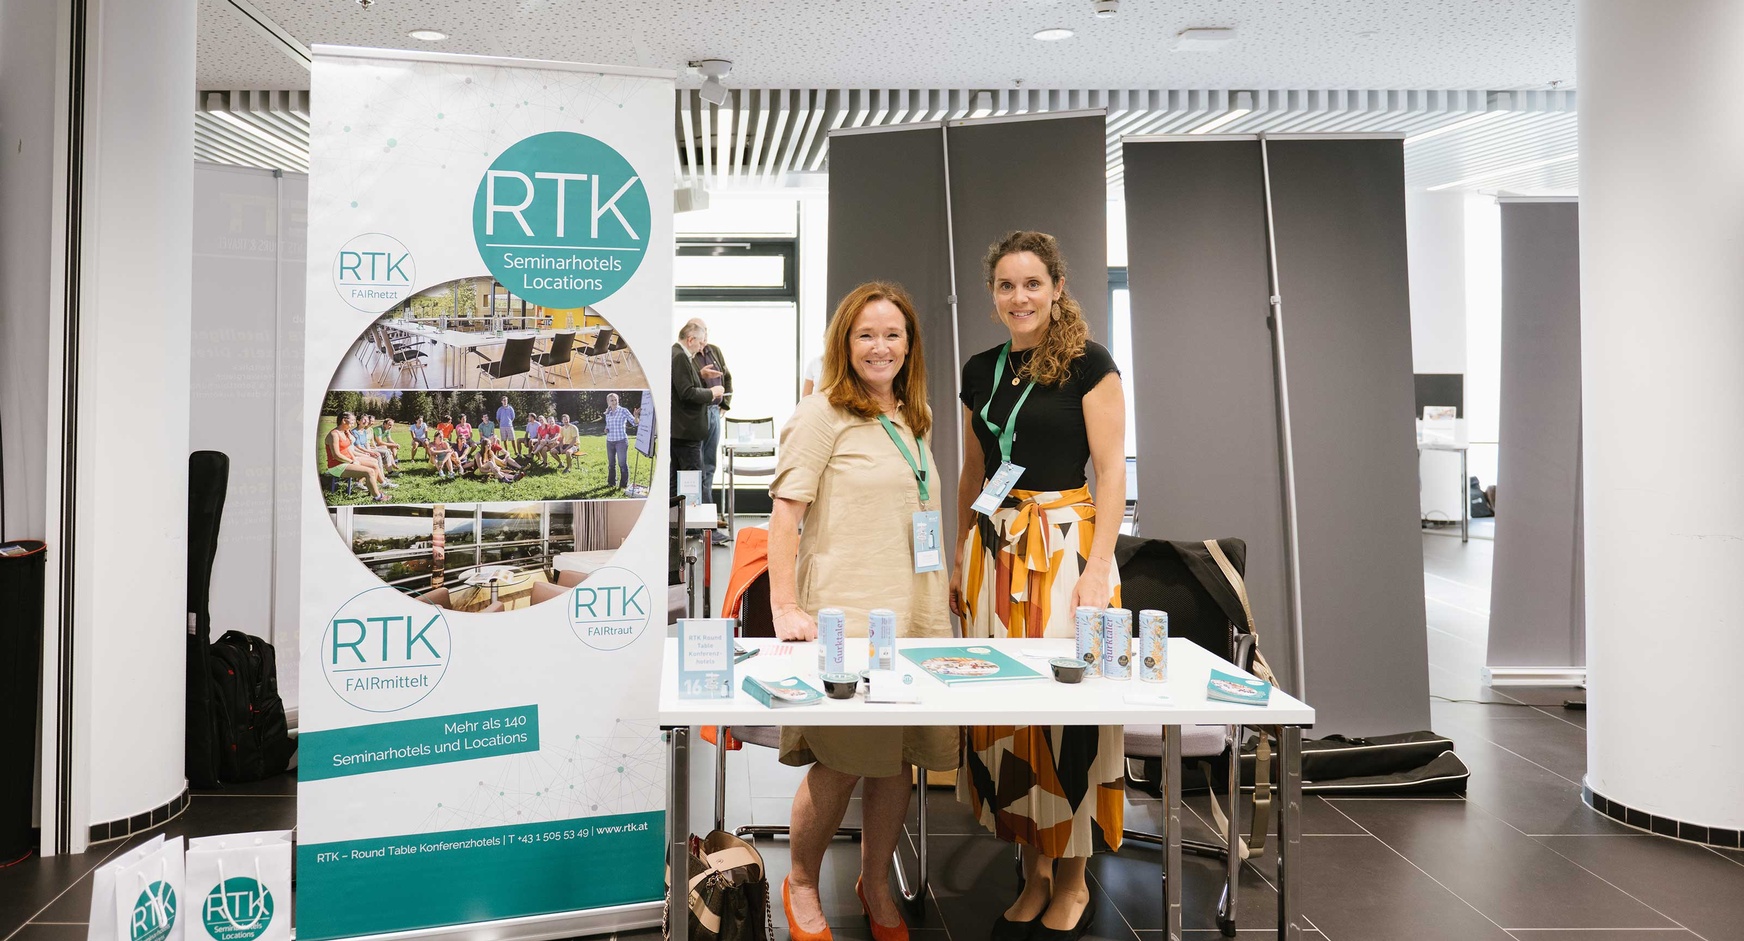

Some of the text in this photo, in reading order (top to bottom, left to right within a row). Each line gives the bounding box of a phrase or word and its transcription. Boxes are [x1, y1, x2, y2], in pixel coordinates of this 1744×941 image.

[485, 169, 640, 240] RTK
[339, 251, 409, 282] RTK
[503, 252, 622, 271] Seminarhotels
[351, 288, 398, 300] FAIRnetzt
[523, 273, 603, 291] Locations
[574, 585, 645, 618] RTK
[332, 614, 441, 664] RTK
[588, 625, 633, 637] FAIRtraut
[833, 618, 843, 664] Gurktaler
[1105, 618, 1115, 663] Gurktaler
[345, 673, 429, 691] FAIRmittelt
[683, 679, 702, 695] 16
[444, 715, 527, 735] Mehr als 140
[332, 731, 528, 767] Seminarhotels und Locations
[317, 852, 339, 863] RTK
[351, 846, 385, 859] Round
[388, 845, 417, 856] Table
[419, 836, 500, 853] Konferenzhotels
[508, 834, 515, 844] T
[517, 833, 534, 844] +43
[536, 833, 541, 842] 1
[543, 831, 561, 842] 505
[563, 830, 575, 840] 53
[577, 828, 589, 838] 49
[596, 821, 648, 834] www.rtk.at
[206, 889, 270, 921] RTK
[221, 931, 255, 941] Locations
